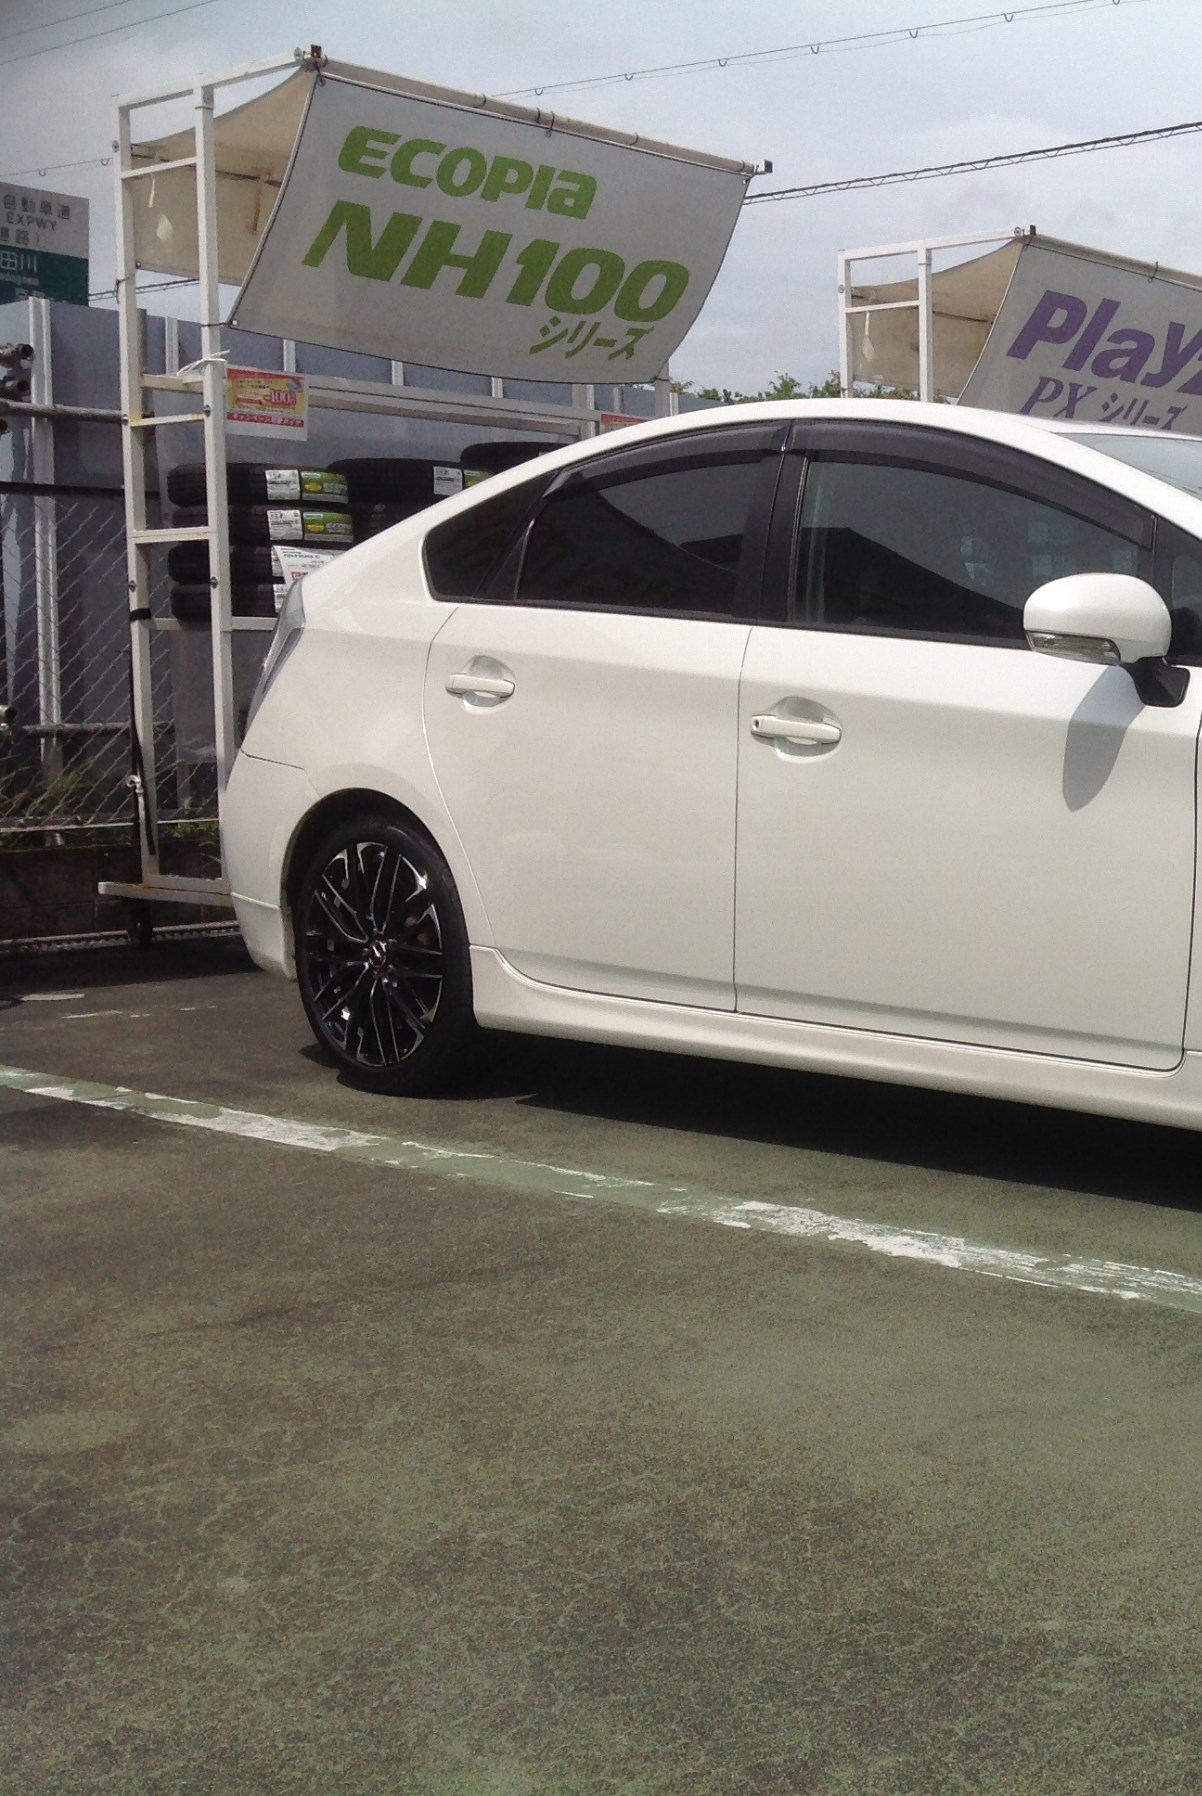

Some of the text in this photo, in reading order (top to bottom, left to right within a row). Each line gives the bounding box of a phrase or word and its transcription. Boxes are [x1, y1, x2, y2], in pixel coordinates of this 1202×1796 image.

[6, 210, 57, 232] EXPWY
[303, 199, 690, 323] NH100
[529, 315, 655, 360] シリーズ
[1018, 375, 1188, 430] PX シリーズ
